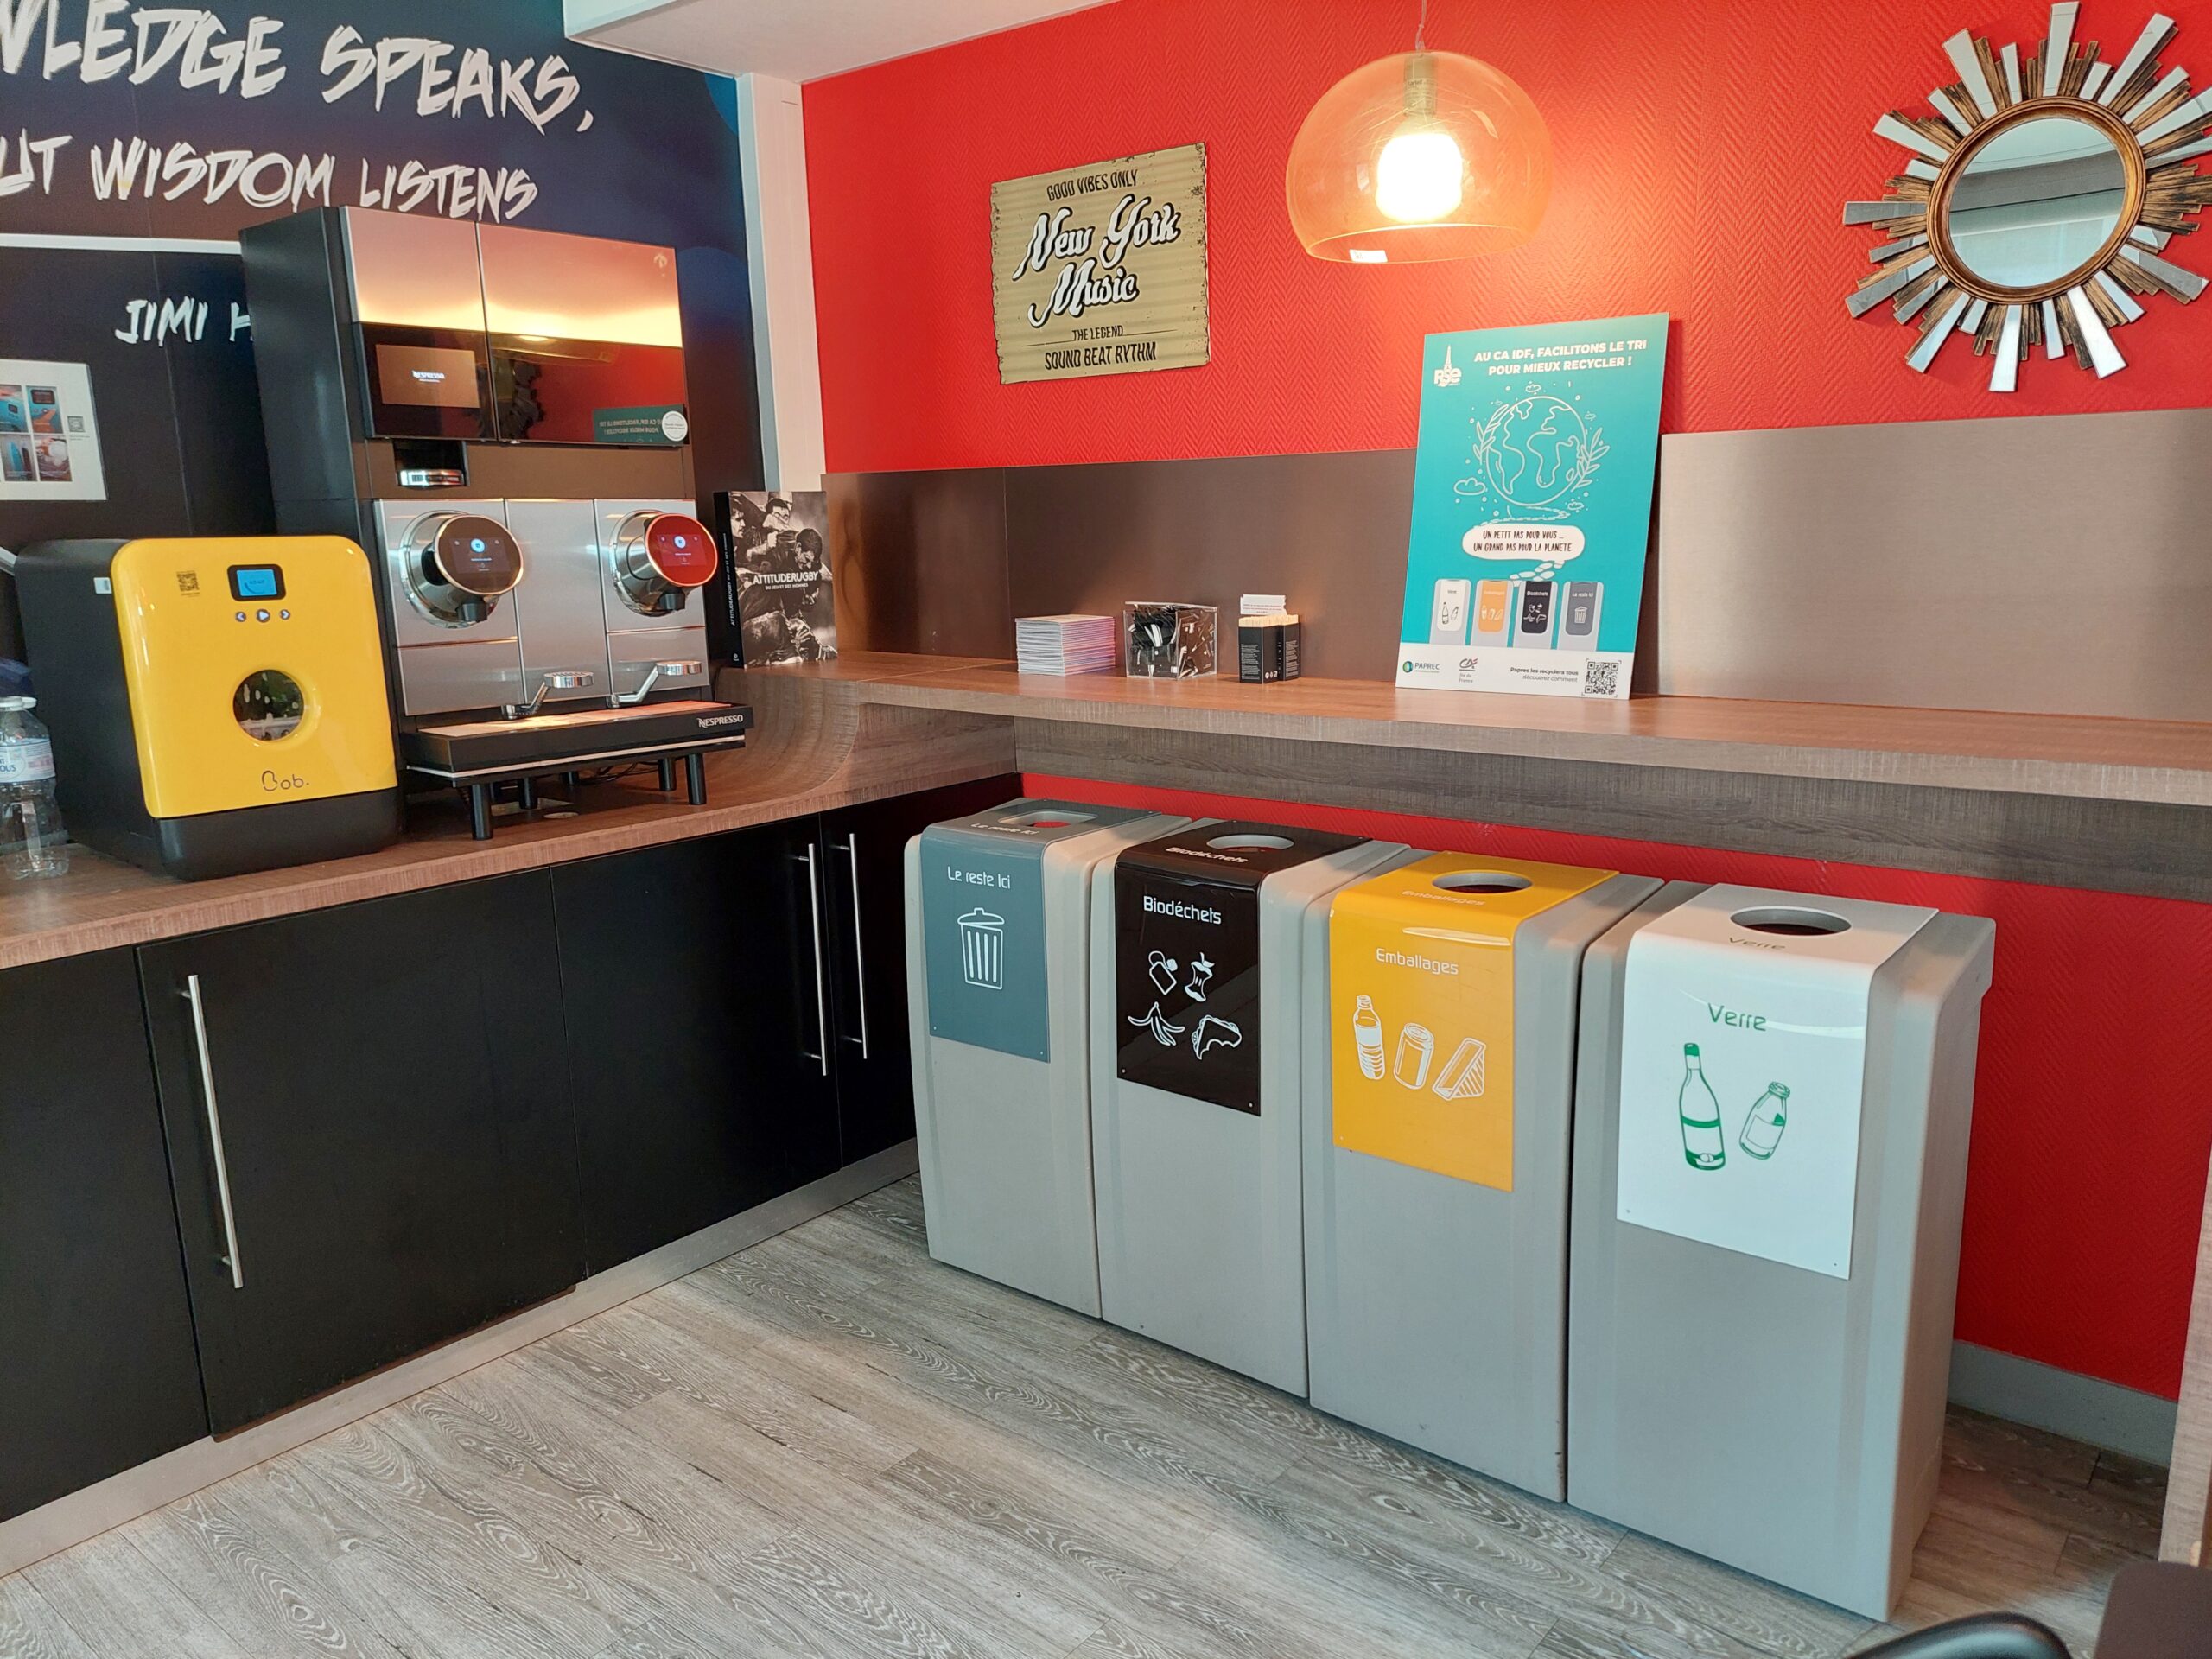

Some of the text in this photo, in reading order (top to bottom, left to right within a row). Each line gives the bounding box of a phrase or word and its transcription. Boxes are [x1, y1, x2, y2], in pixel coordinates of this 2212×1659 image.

[321, 25, 594, 135] SPEAKS,
[91, 137, 336, 213] WISDOM
[359, 158, 539, 224] LISTENS
[1046, 168, 1138, 201] GOOD VIBES ONLY
[1012, 193, 1182, 282] New York
[1027, 257, 1140, 328] Music
[115, 296, 208, 347] JIMI
[1072, 325, 1123, 342] THE LEGEND
[1044, 341, 1157, 371] SOUND BEAT RYTHM
[1474, 339, 1648, 362] AU CA IDF, FACILITONS LE TRI
[1488, 356, 1632, 376] POUR MIEUX RECYCLER !
[1483, 531, 1491, 539] UN
[1494, 531, 1511, 539] PETIT
[1514, 531, 1524, 539] PAS
[1526, 531, 1540, 539] POUR
[1542, 531, 1558, 539] VOUS
[1473, 543, 1573, 552] UN GRAND PAS POUR LA PLANETE
[753, 571, 819, 585] ATTITUDERUGBY
[696, 715, 743, 728] NESPRESSO
[1165, 847, 1249, 863] Biodéchets
[947, 866, 1011, 889] Le reste Ici
[1401, 890, 1486, 906] Emballages
[1143, 895, 1222, 925] Biodéchets
[1729, 937, 1786, 950] Verre
[1376, 947, 1459, 975] Emballages
[1707, 1002, 1767, 1032] Verre
